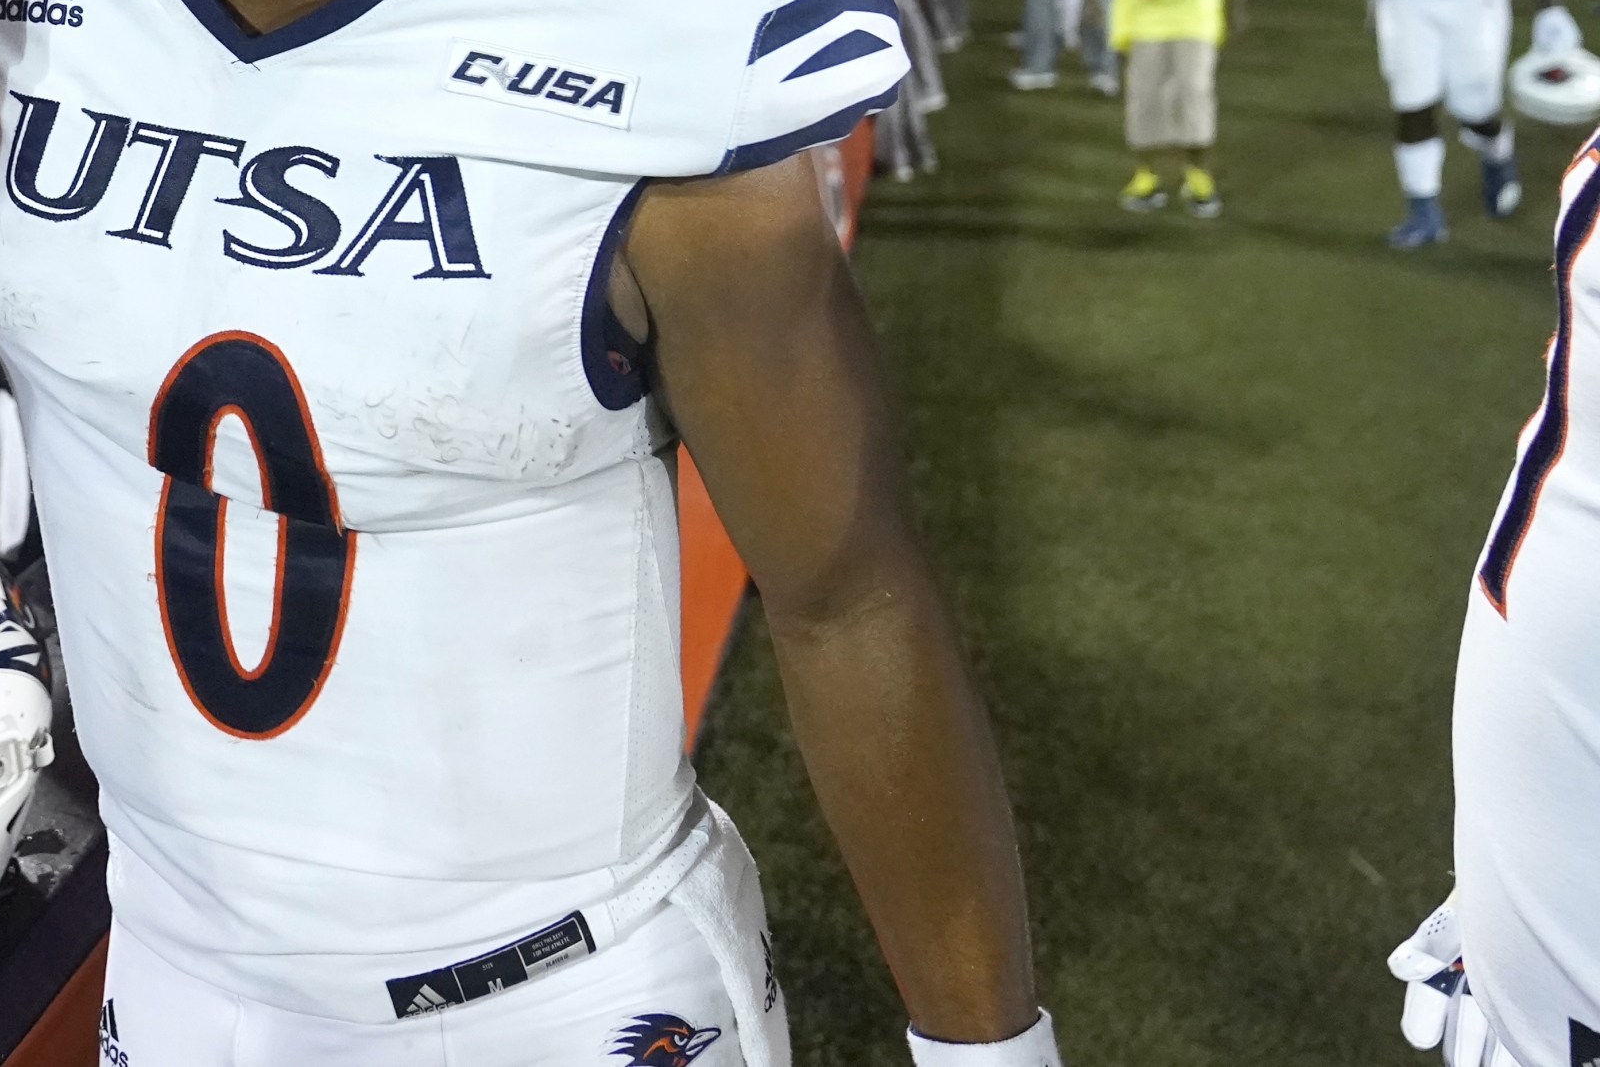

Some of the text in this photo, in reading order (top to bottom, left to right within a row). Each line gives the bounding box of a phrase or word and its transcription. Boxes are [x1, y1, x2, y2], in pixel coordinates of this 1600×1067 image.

[5, 91, 492, 280] UTSA
[148, 330, 358, 740] 0
[487, 977, 505, 995] M
